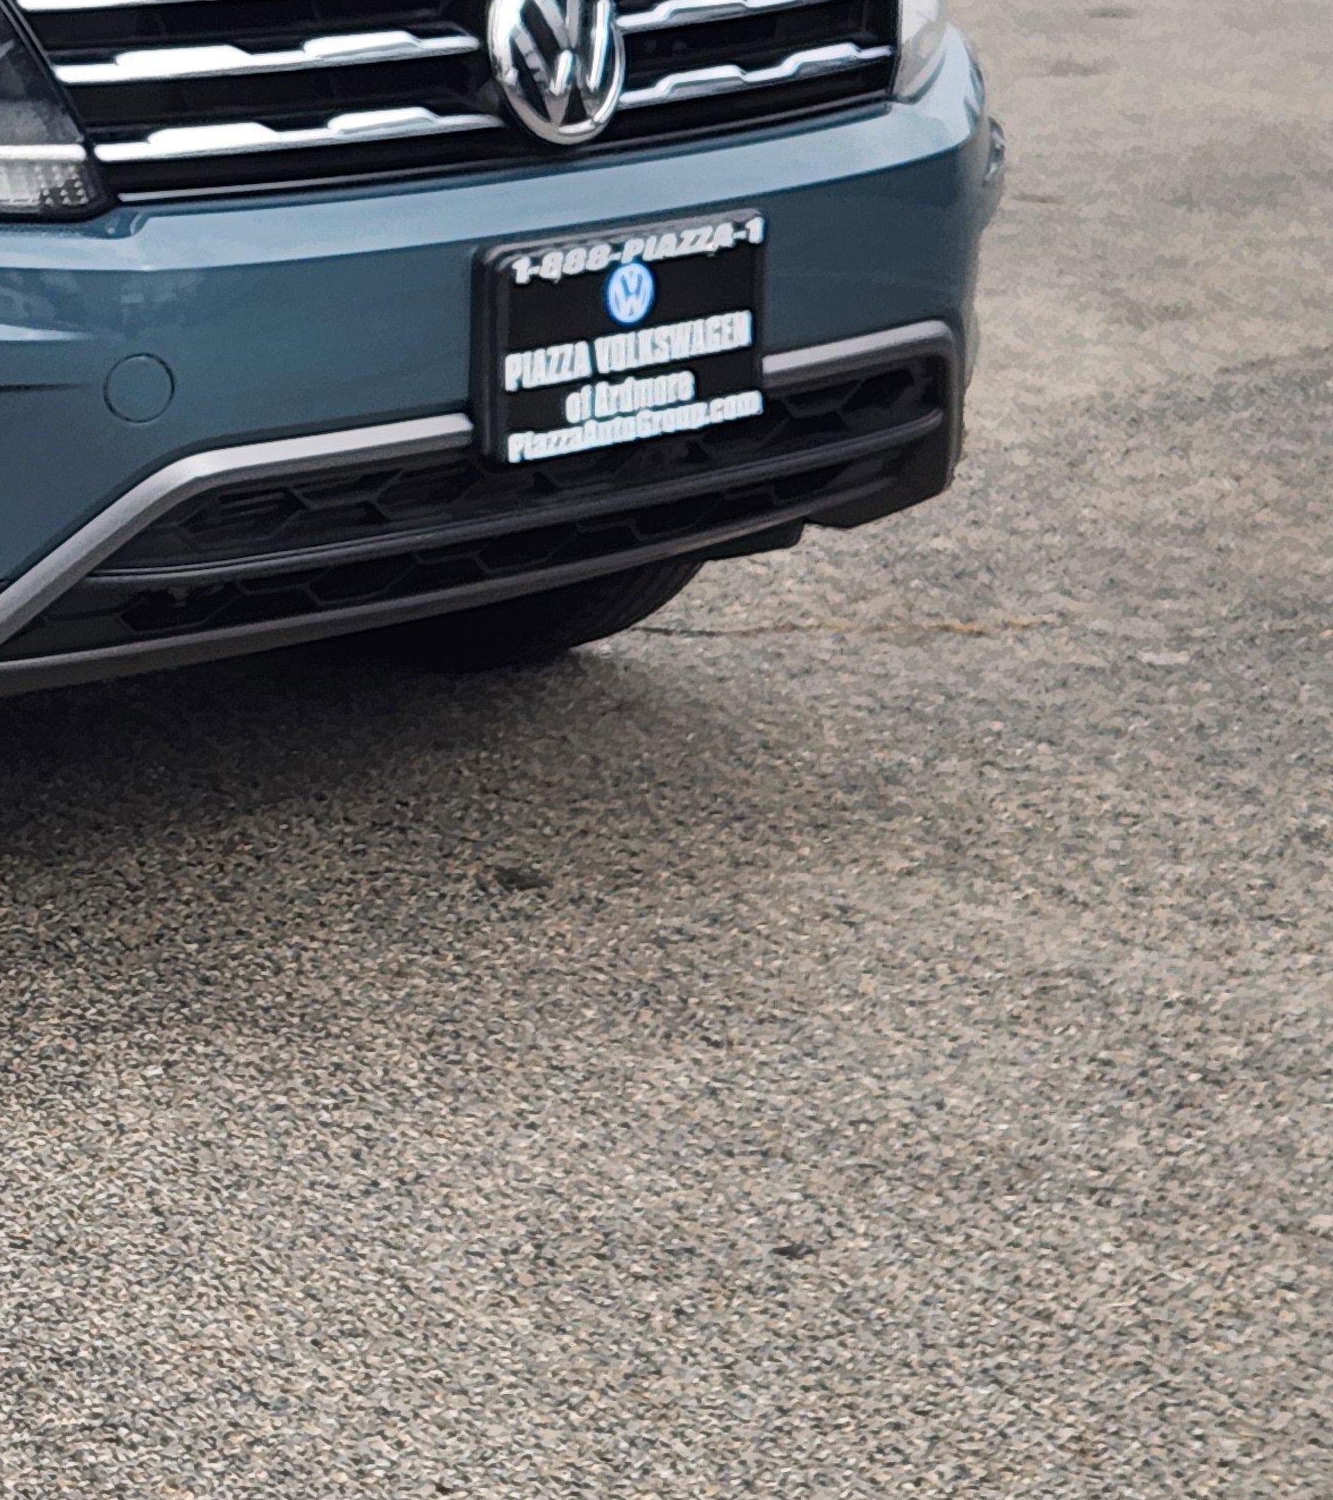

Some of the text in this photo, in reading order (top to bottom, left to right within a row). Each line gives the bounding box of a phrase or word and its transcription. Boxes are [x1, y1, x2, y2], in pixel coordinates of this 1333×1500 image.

[512, 216, 764, 285] 1-888-PIAZZA-1
[504, 309, 753, 392] PIAZZA VOLKSWAGEN
[507, 389, 764, 464] PiazzaAutoGroup.com
[565, 370, 696, 424] of Ardmore
